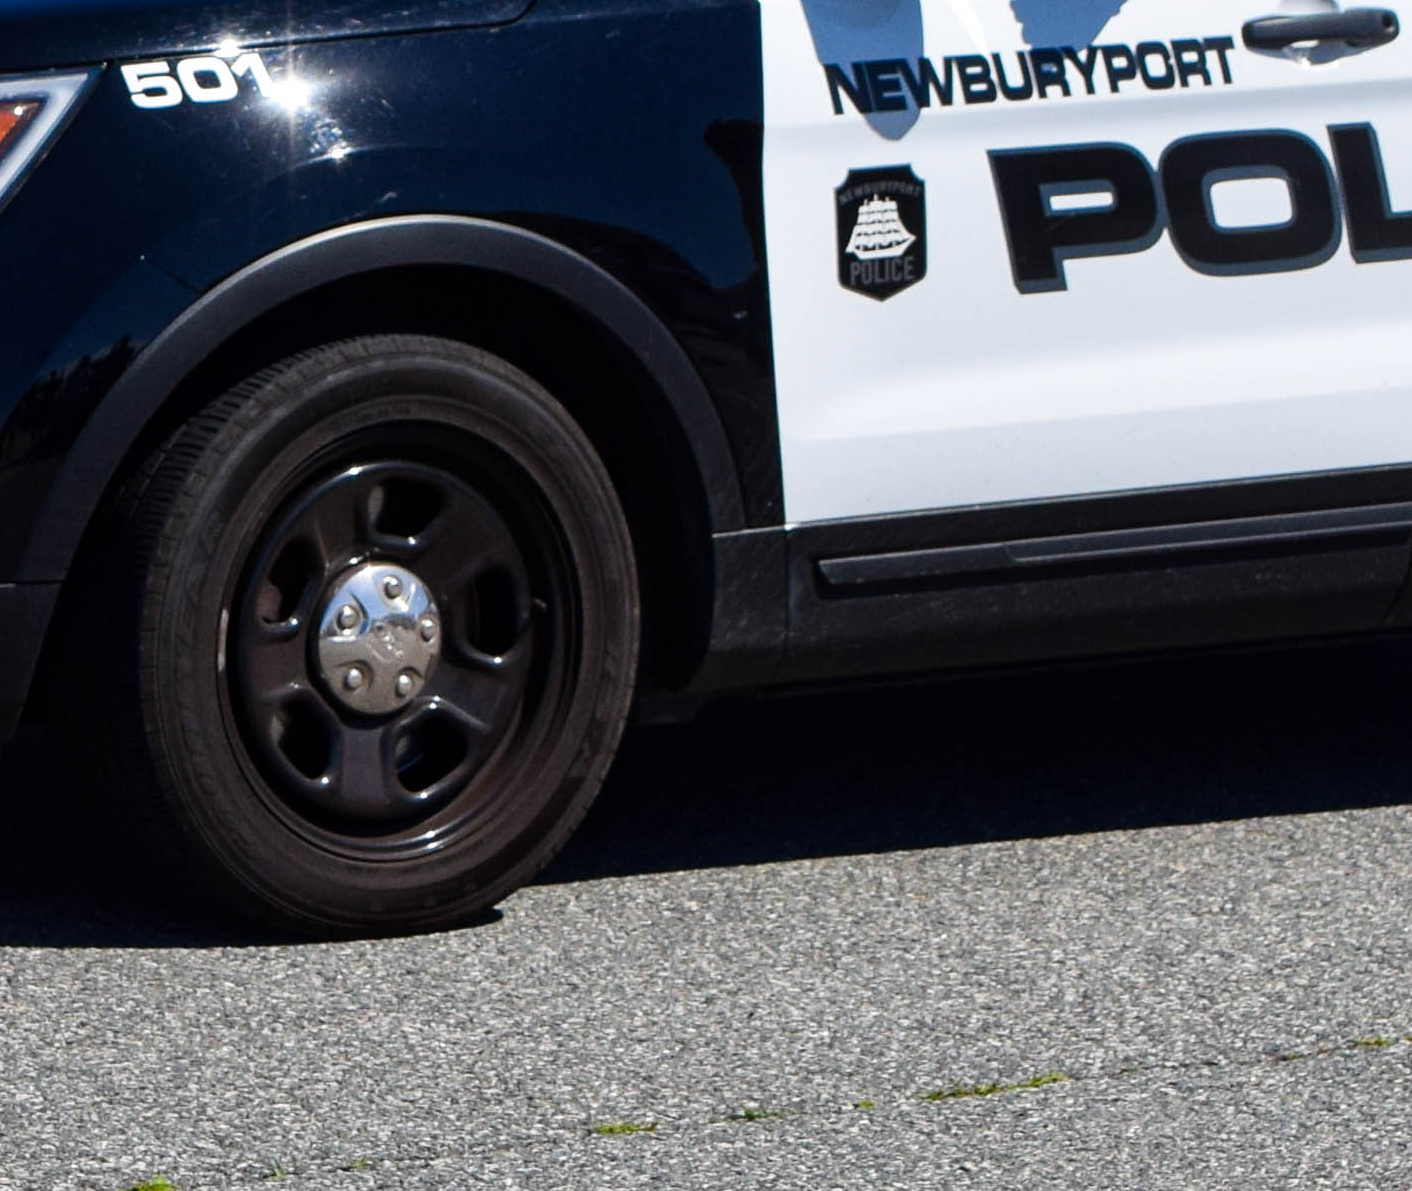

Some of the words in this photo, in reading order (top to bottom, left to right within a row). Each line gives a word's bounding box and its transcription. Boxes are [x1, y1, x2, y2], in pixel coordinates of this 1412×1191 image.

[120, 52, 279, 109] 501
[824, 35, 1235, 116] NEWBURYPORT
[839, 180, 921, 205] NEWBURYPORT
[850, 256, 915, 286] POLICE
